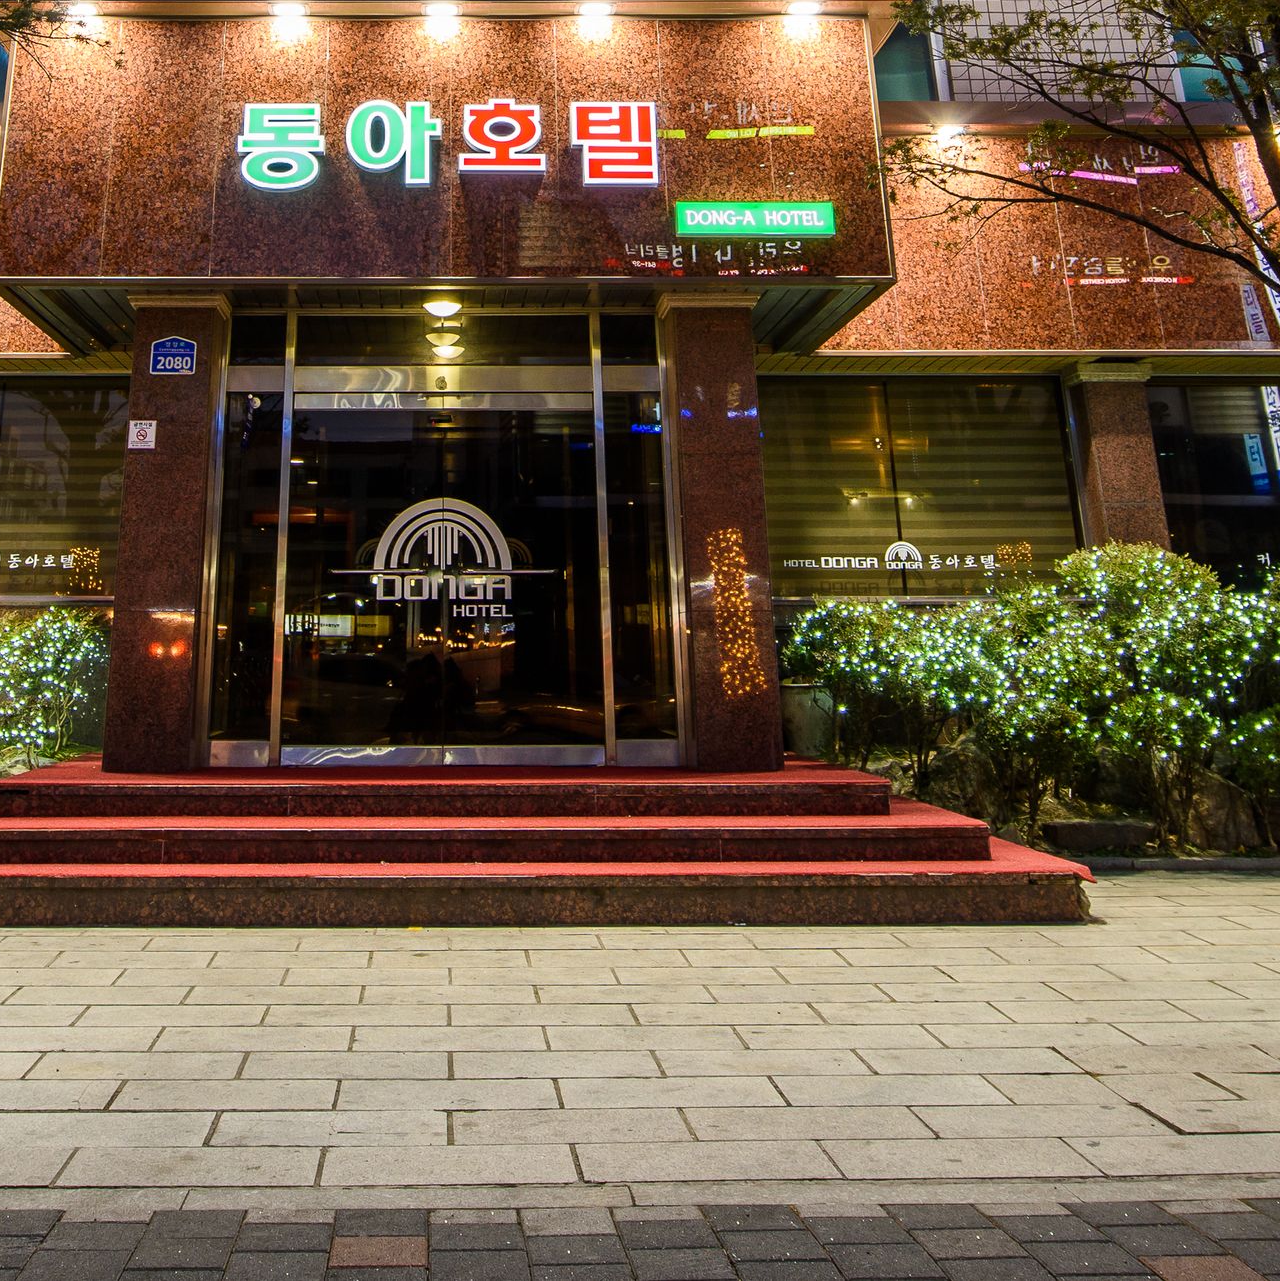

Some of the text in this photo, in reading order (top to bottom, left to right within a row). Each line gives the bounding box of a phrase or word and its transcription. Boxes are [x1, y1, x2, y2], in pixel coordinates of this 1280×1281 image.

[235, 98, 660, 192] 동아호텔
[685, 209, 824, 226] DONG-A HOTEL
[156, 356, 192, 370] 2080
[7, 553, 75, 569] 동아호텔
[783, 556, 879, 569] HOTEL DONGA
[886, 561, 923, 569] DONGA
[928, 554, 996, 570] 동아호텔
[376, 574, 513, 601] DONGA
[453, 604, 513, 617] HOTEL
